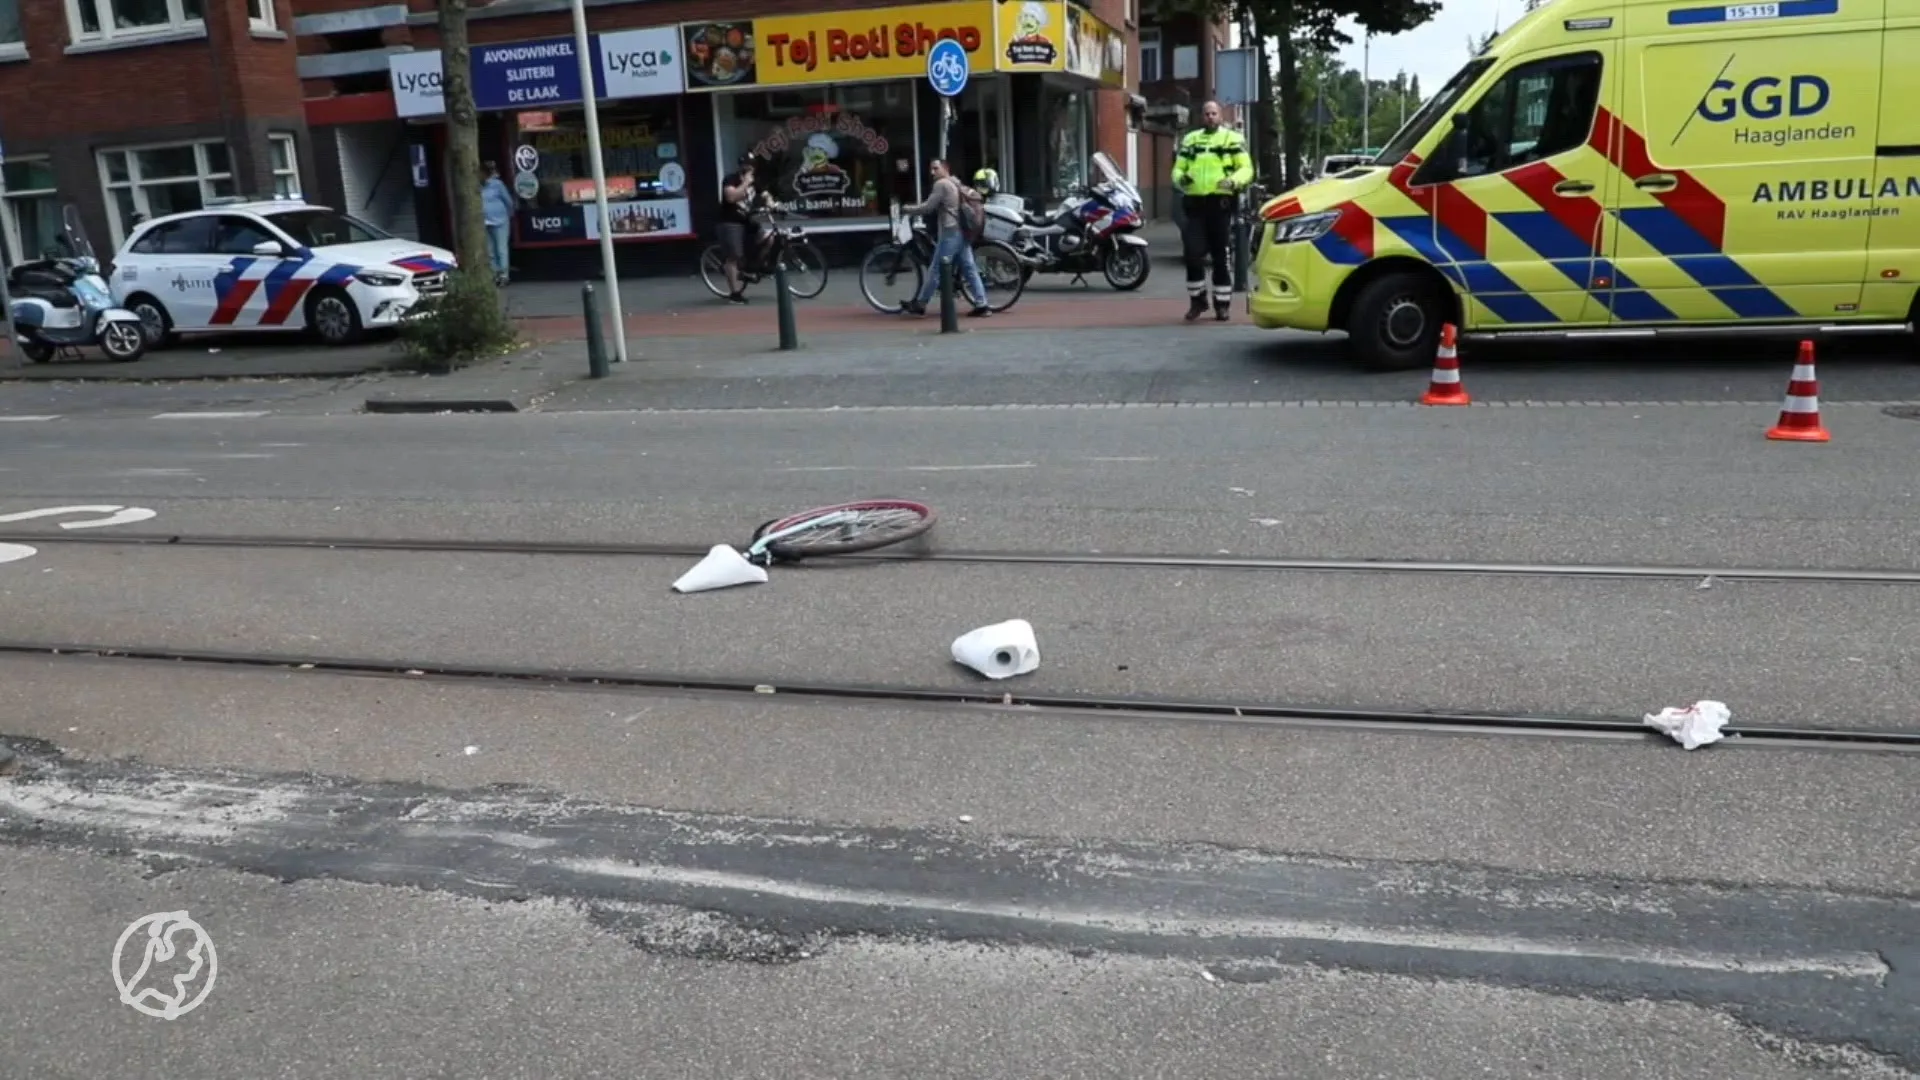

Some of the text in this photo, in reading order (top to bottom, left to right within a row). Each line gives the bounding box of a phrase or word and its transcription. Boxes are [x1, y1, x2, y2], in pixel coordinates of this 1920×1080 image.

[1729, 4, 1776, 18] 15-119
[826, 25, 889, 62] Roti
[484, 43, 574, 63] AVONDWINKEL
[608, 50, 657, 74] Lyca
[397, 71, 443, 93] Lyca
[506, 65, 556, 82] SLIJTERIJ
[631, 69, 658, 79] Mobile
[508, 86, 560, 101] DE LAAK
[1698, 74, 1830, 122] GGD
[836, 113, 889, 155] Shop
[1734, 122, 1855, 146] Haaglanden
[841, 195, 865, 209] Nasi
[1777, 207, 1900, 220] RAV Haaglanden
[531, 215, 562, 231] Lyca
